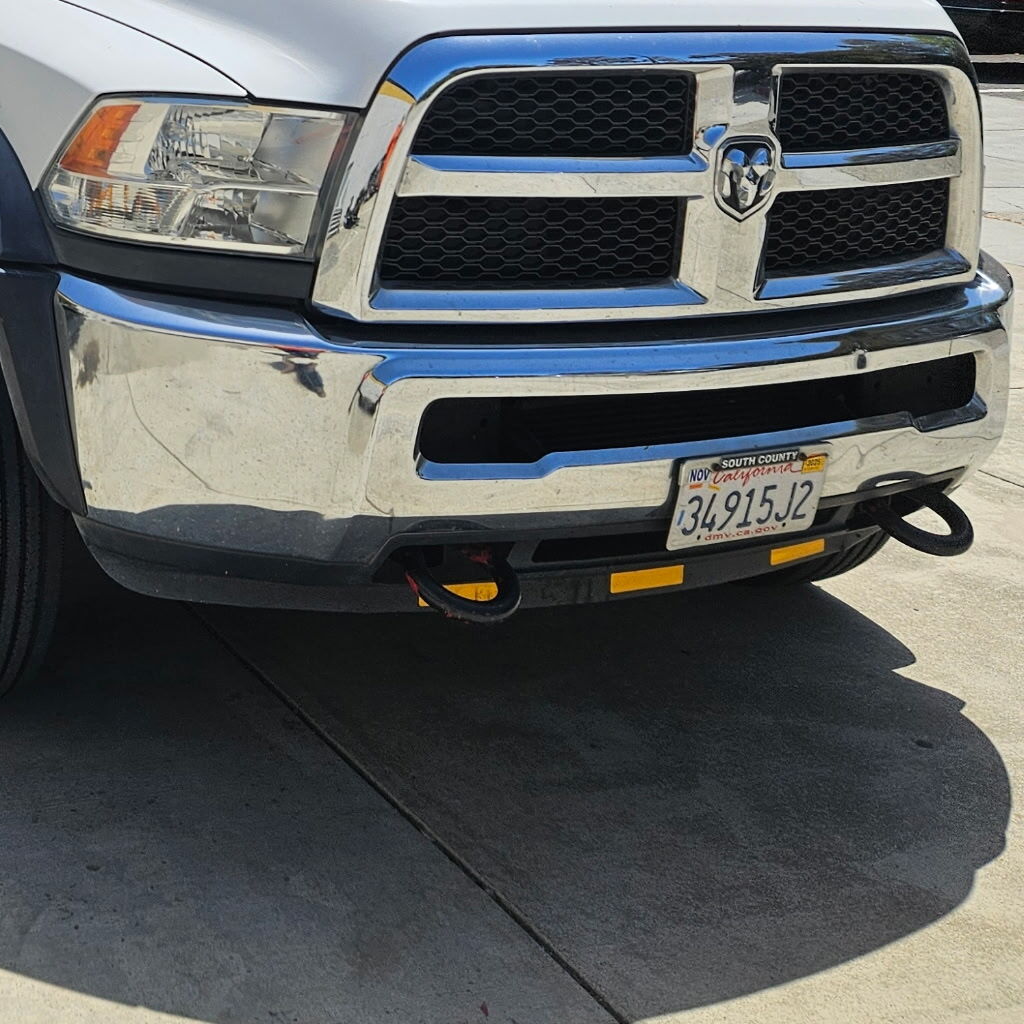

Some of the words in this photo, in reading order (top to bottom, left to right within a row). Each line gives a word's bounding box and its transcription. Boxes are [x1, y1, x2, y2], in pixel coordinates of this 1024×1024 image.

[720, 457, 756, 469] SOUTH
[758, 451, 799, 465] COUNTY
[689, 468, 710, 483] NOV
[712, 462, 803, 486] California
[681, 480, 814, 536] 34915J2
[704, 525, 779, 541] dmv.ca.gov
